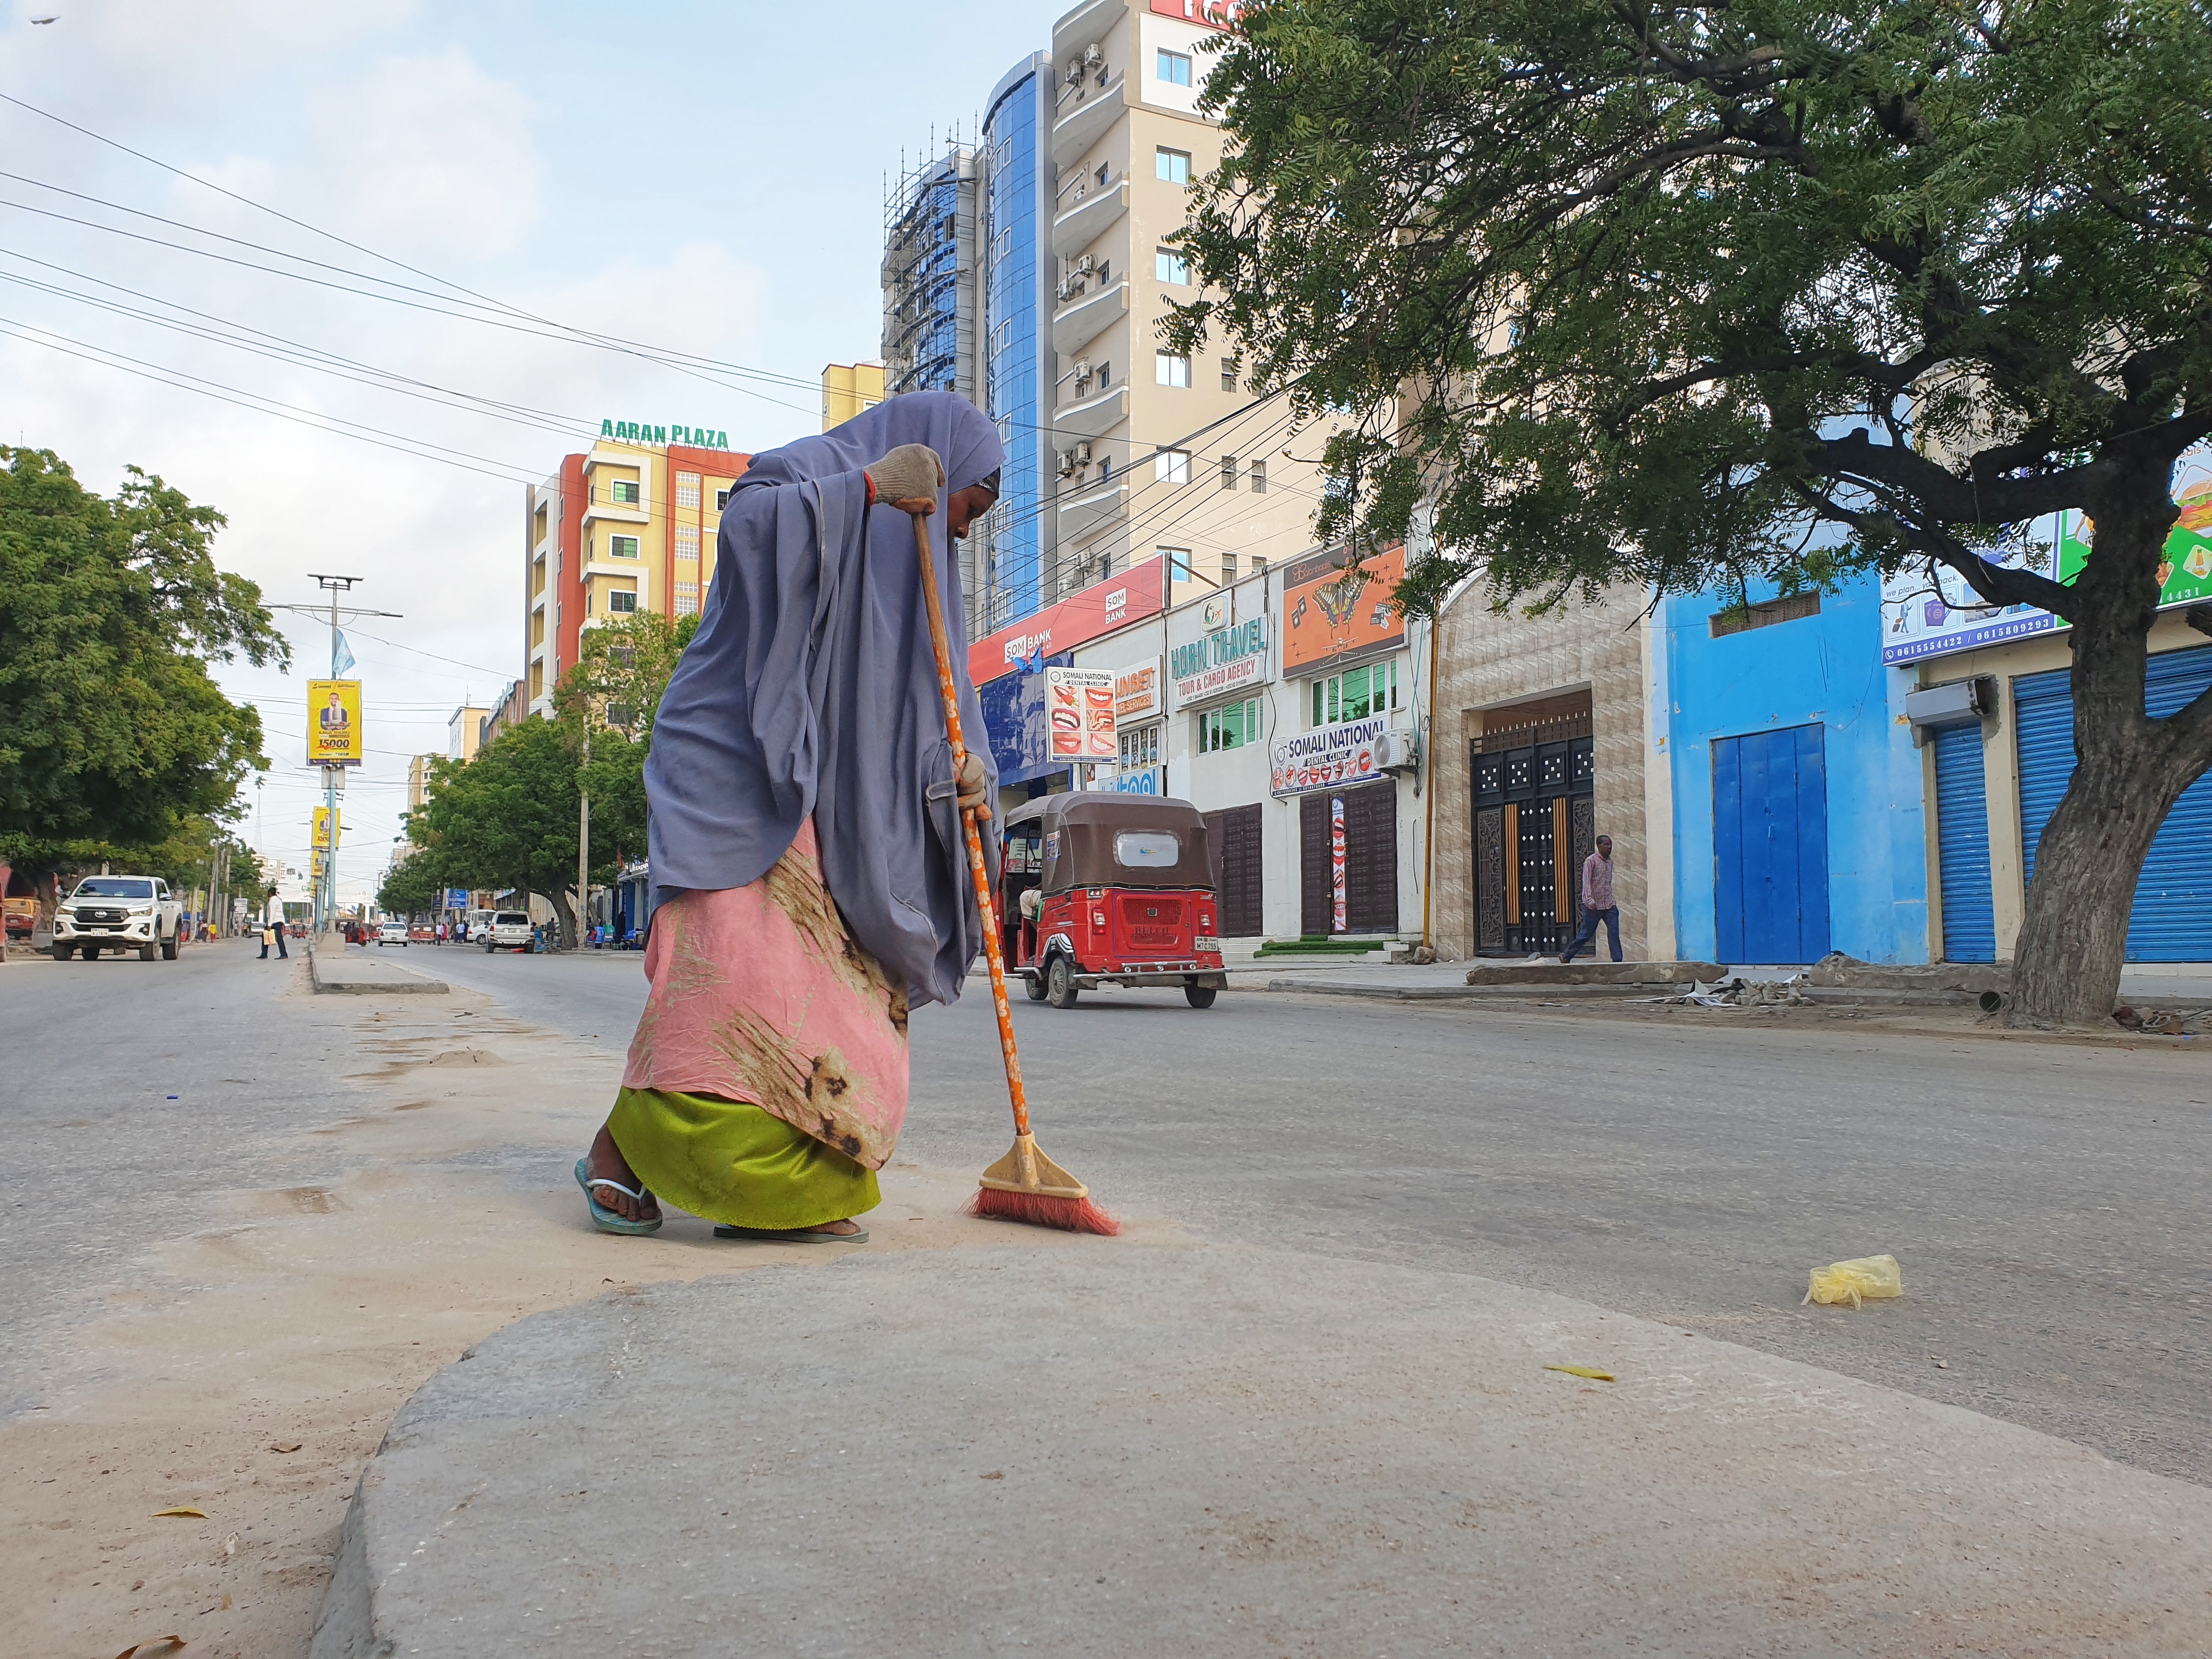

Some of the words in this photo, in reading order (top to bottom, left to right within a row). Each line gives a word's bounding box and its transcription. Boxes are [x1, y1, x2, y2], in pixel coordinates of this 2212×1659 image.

[601, 419, 665, 443] AARAN
[672, 424, 729, 449] PLAZA
[1108, 592, 1124, 607] SOM
[1105, 607, 1126, 624] BANK
[1007, 641, 1024, 658] SOM
[1028, 628, 1052, 648] BANK
[1171, 639, 1210, 679] HORN
[1211, 617, 1266, 665] TRAVEL
[1897, 637, 1962, 657] 0615554422
[1976, 619, 2050, 641] 0615809293
[1063, 672, 1084, 680] SOMALI
[1115, 667, 1155, 697] UNSET
[1178, 679, 1194, 697] TOUR
[1197, 678, 1202, 690] &
[1204, 669, 1225, 689] CARGO
[1227, 659, 1255, 682] AGENCY
[1126, 694, 1150, 711] SERVICES
[319, 739, 349, 748] 15000
[1289, 733, 1326, 758] SOMALI
[1307, 757, 1328, 766] DENTAL
[1329, 751, 1347, 762] CLINIC
